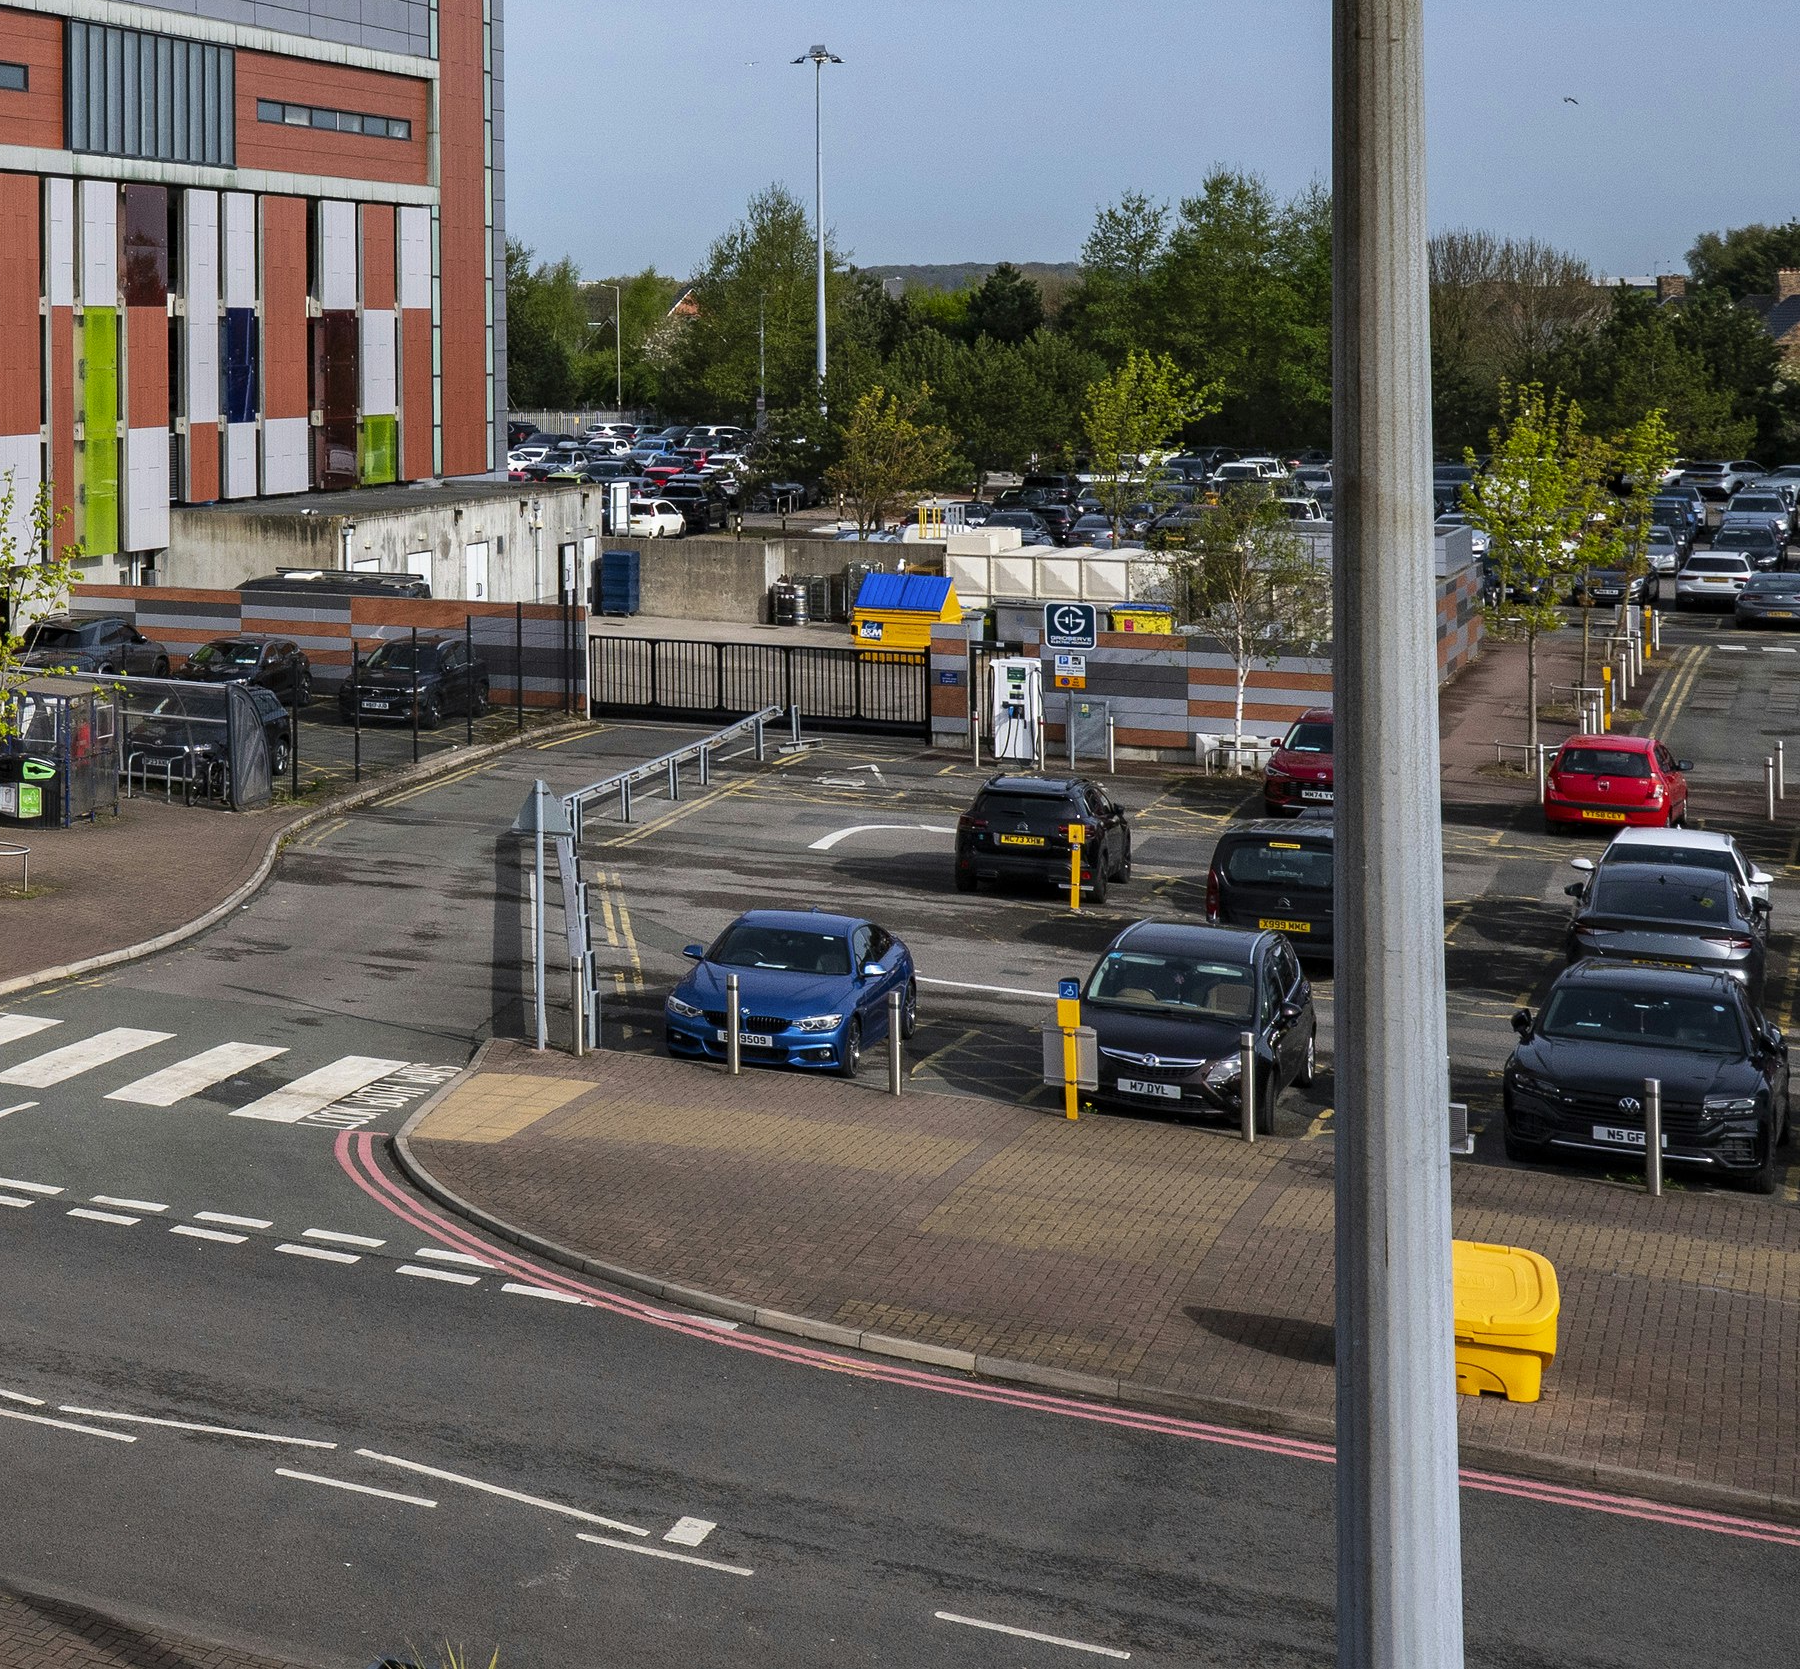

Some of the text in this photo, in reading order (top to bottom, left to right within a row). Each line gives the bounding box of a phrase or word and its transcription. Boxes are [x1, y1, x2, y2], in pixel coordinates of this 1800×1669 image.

[860, 628, 882, 638] B&M
[1262, 919, 1286, 929] X999
[740, 1034, 767, 1045] 9509
[1130, 1081, 1169, 1095] M7 DYL
[1607, 1128, 1645, 1143] N5 GF
